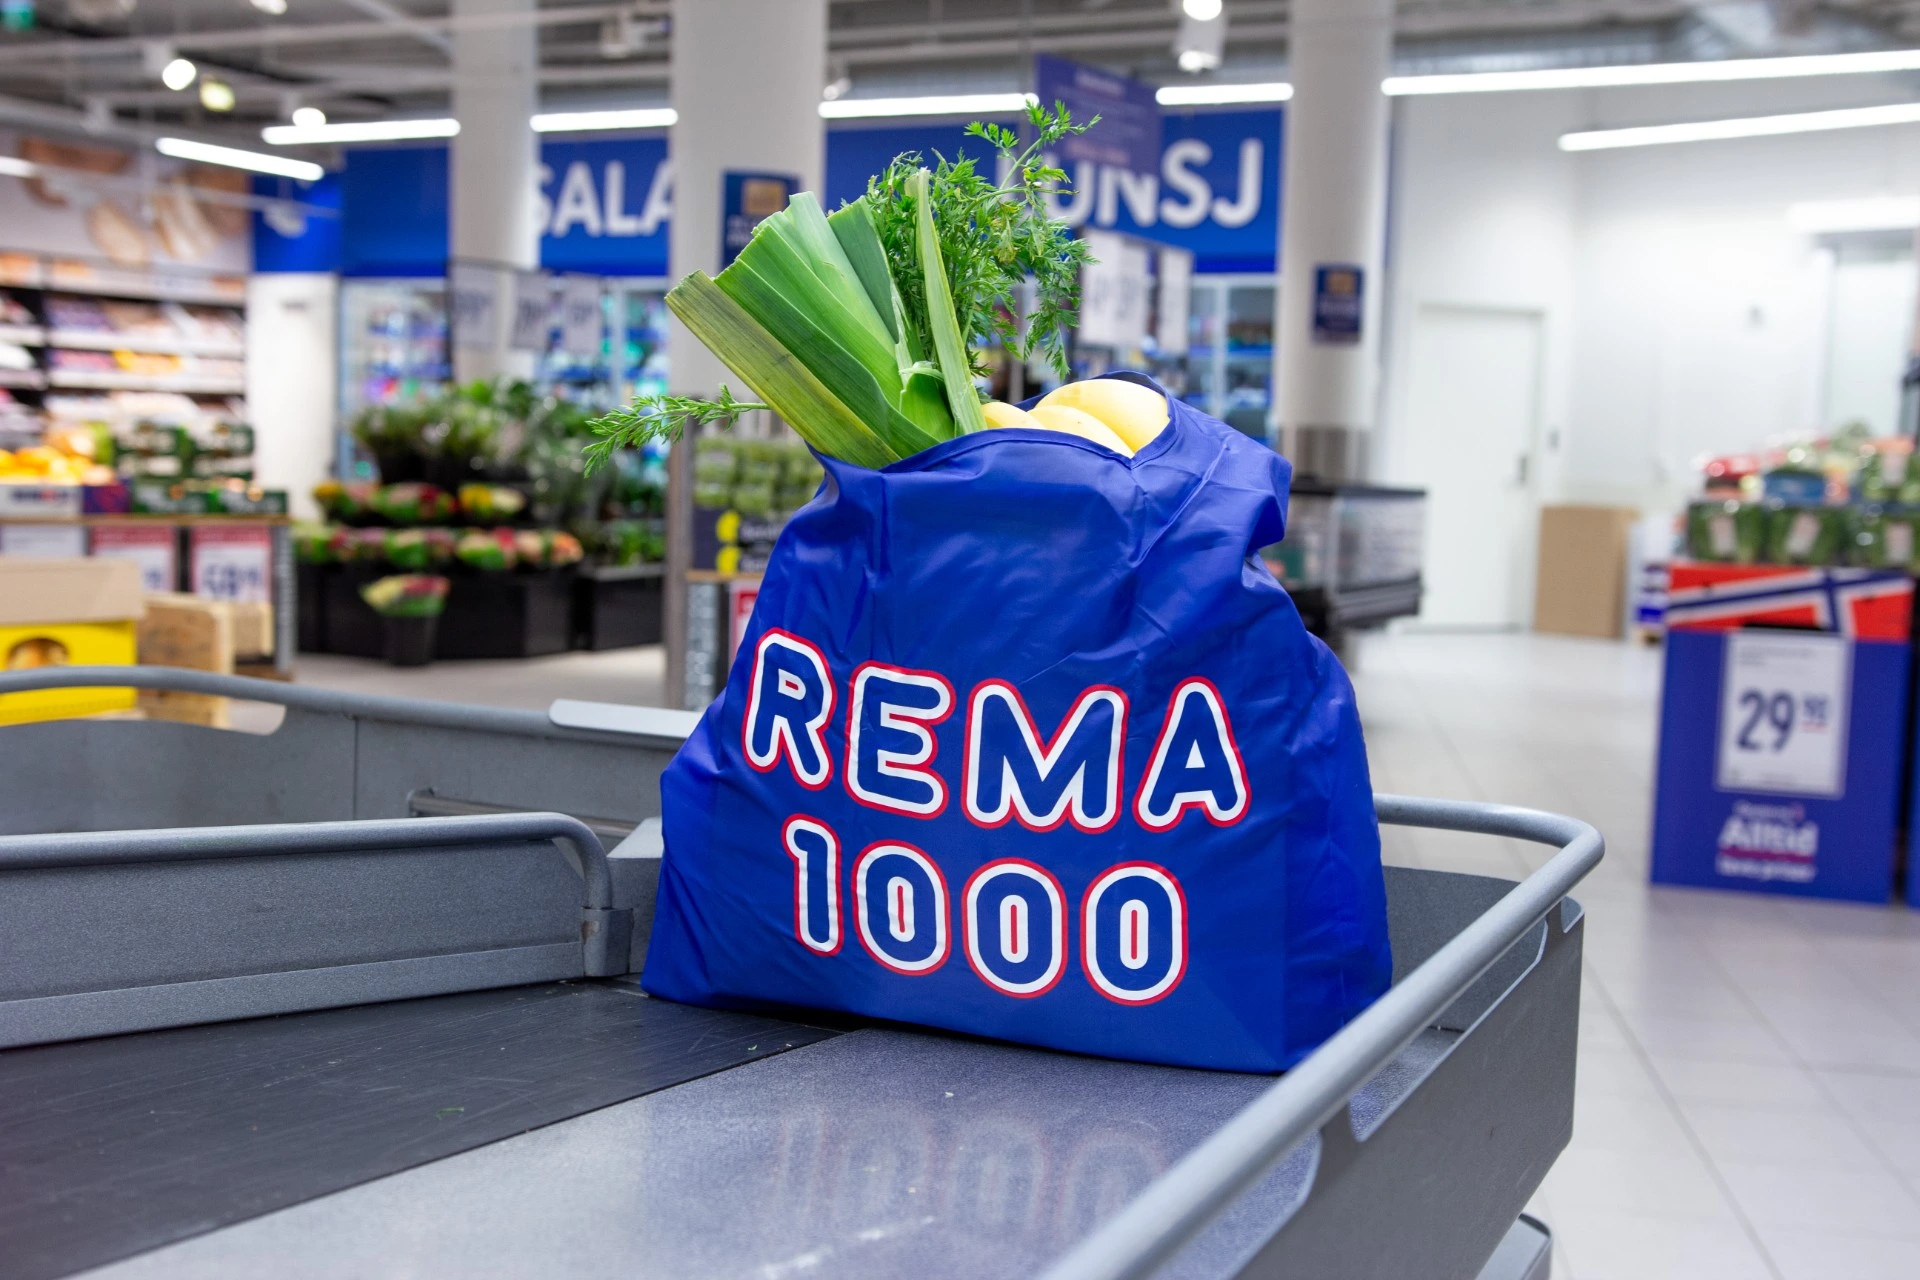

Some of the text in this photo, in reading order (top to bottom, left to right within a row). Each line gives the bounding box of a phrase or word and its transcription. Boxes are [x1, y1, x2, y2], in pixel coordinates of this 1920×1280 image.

[742, 627, 1250, 833] REMA
[1736, 688, 1795, 753] 29
[782, 814, 1188, 1006] 1000
